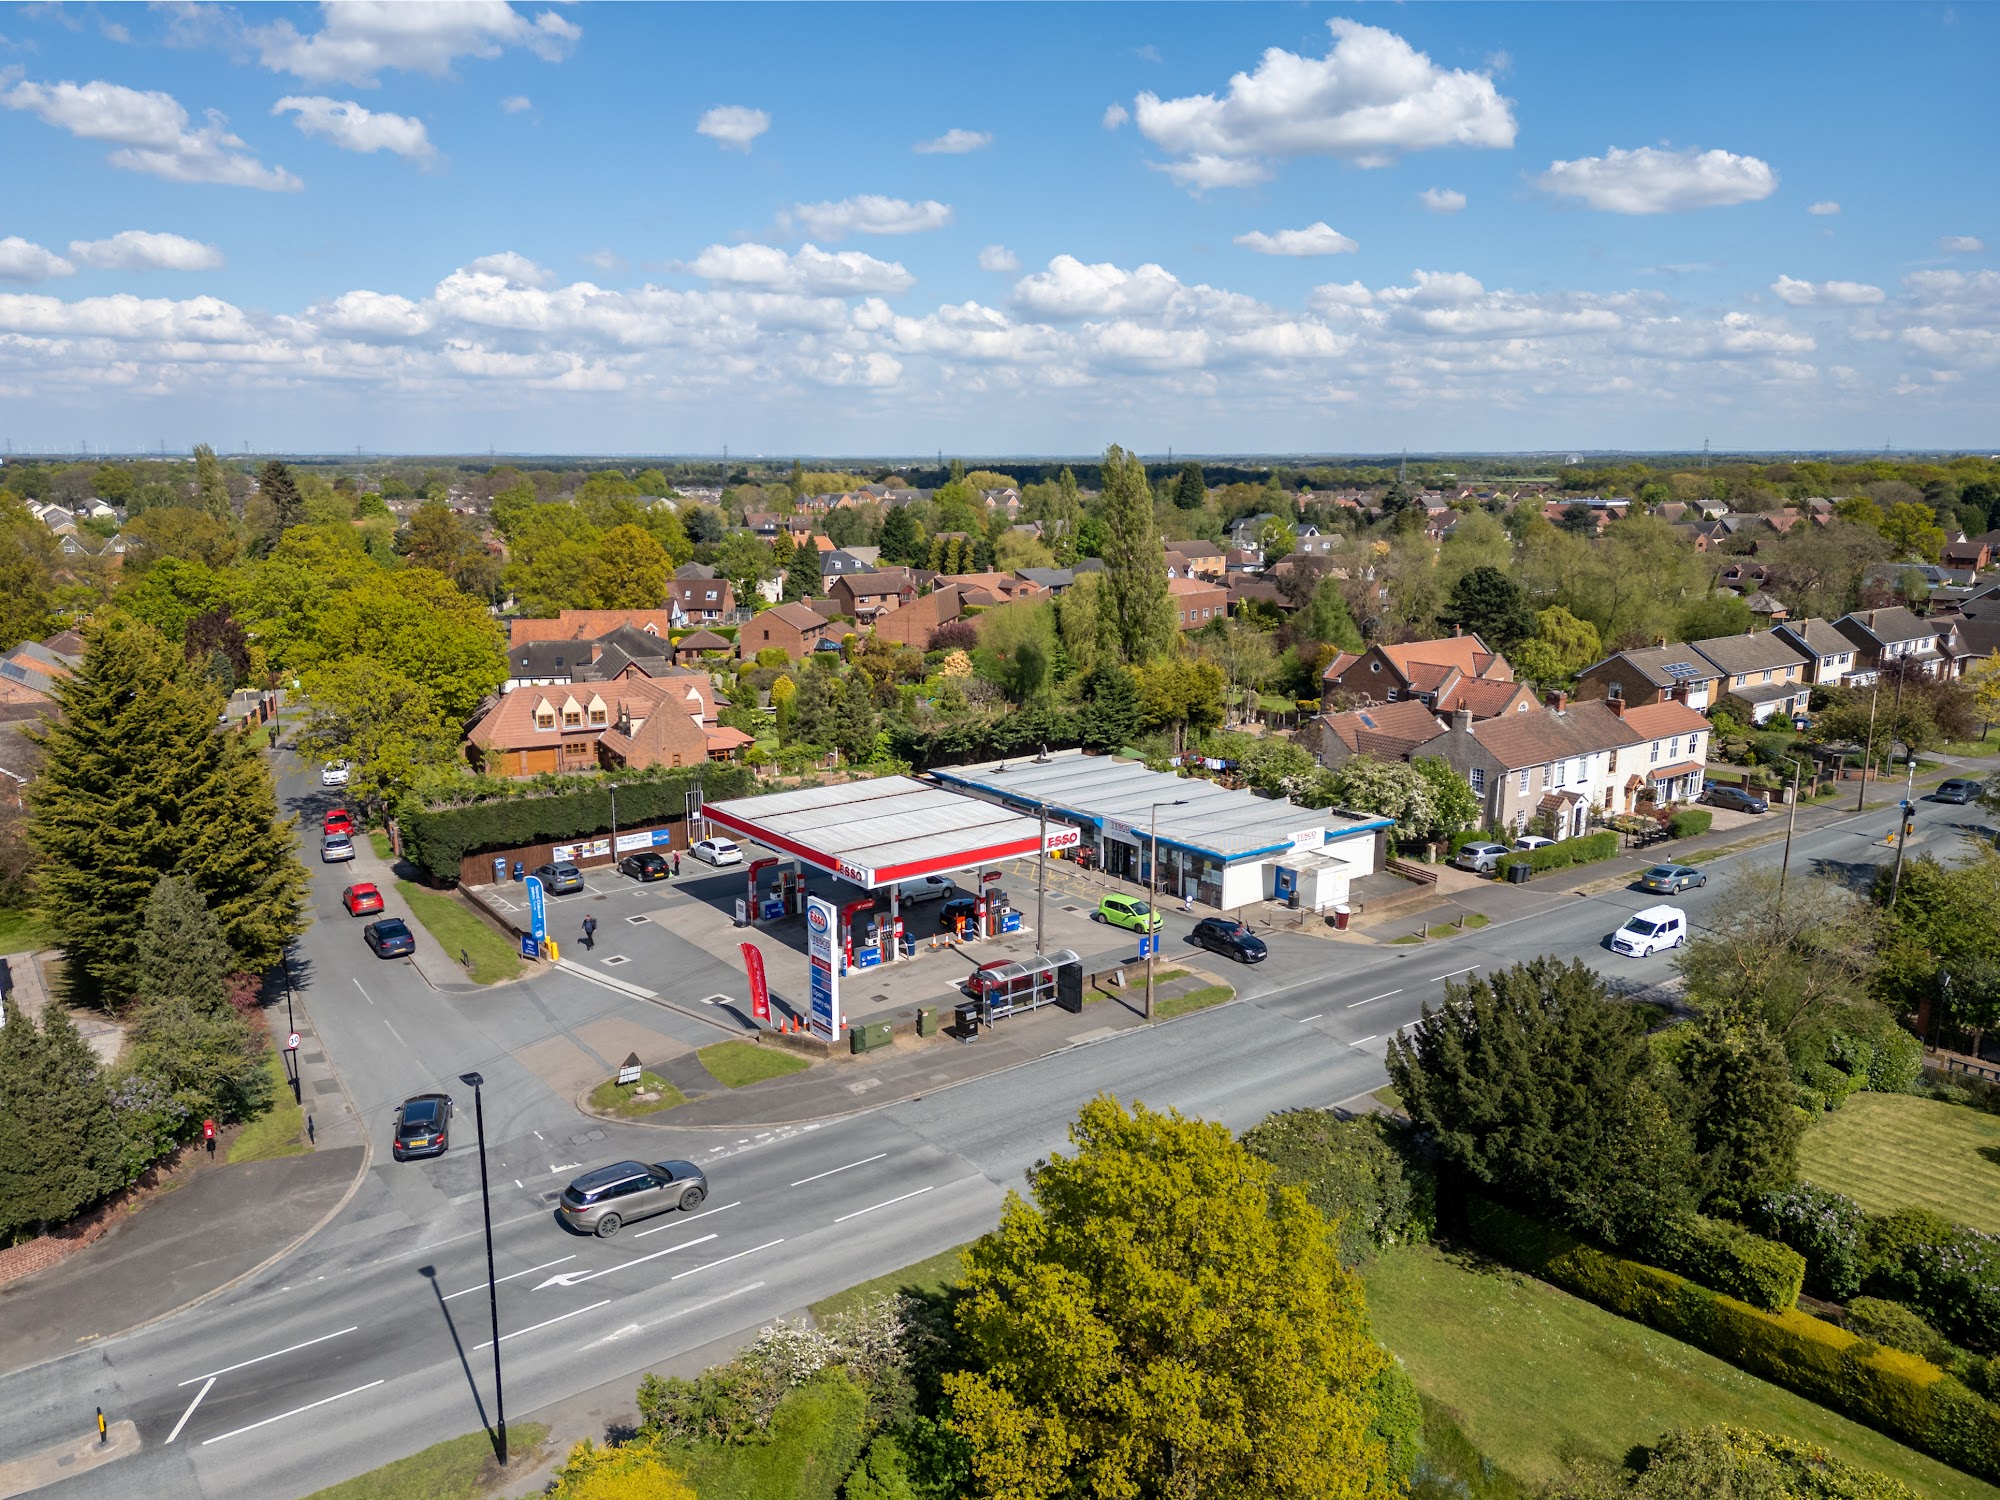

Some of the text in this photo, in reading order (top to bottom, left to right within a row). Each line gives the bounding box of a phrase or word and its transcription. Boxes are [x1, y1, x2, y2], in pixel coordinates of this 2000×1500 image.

[1111, 822, 1130, 832] TESCO
[1047, 832, 1078, 848] ESSO
[1297, 831, 1317, 840] TESCO
[840, 865, 862, 881] ESSO
[812, 935, 830, 949] TESCO
[290, 1036, 299, 1045] 30
